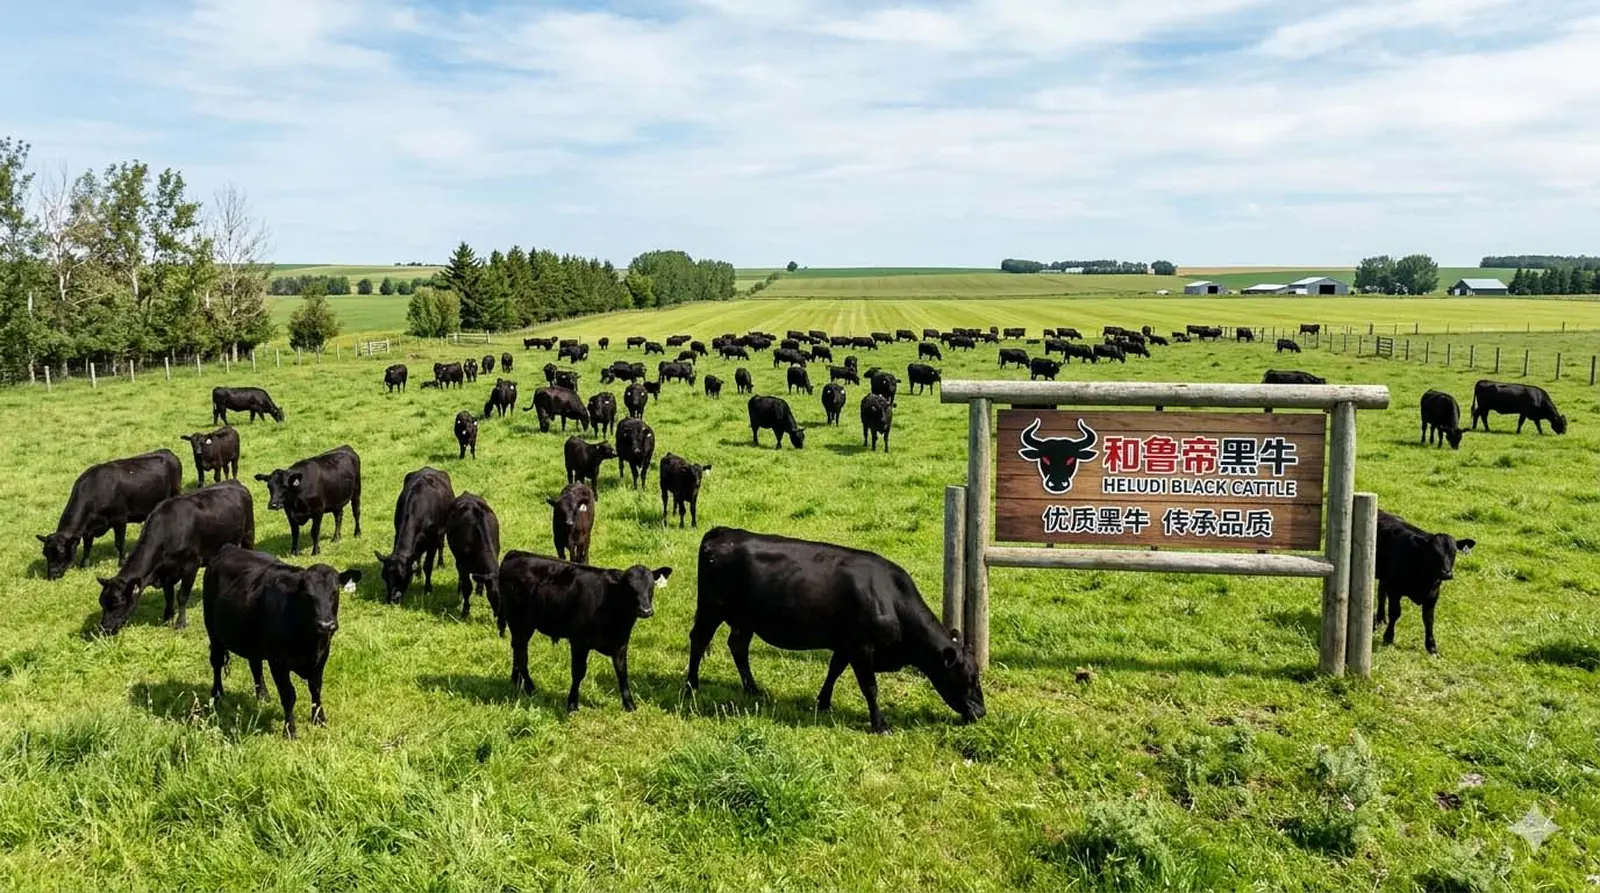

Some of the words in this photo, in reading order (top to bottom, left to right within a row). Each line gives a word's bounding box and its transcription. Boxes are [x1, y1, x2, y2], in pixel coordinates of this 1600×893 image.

[1103, 435, 1297, 475] 和鲁帝黑牛
[1103, 478, 1167, 493] HELUDI
[1171, 479, 1227, 495] BLACK
[1231, 480, 1296, 496] CATTLE
[1043, 506, 1149, 534] 优质黑牛
[1162, 508, 1272, 536] 传承品质
